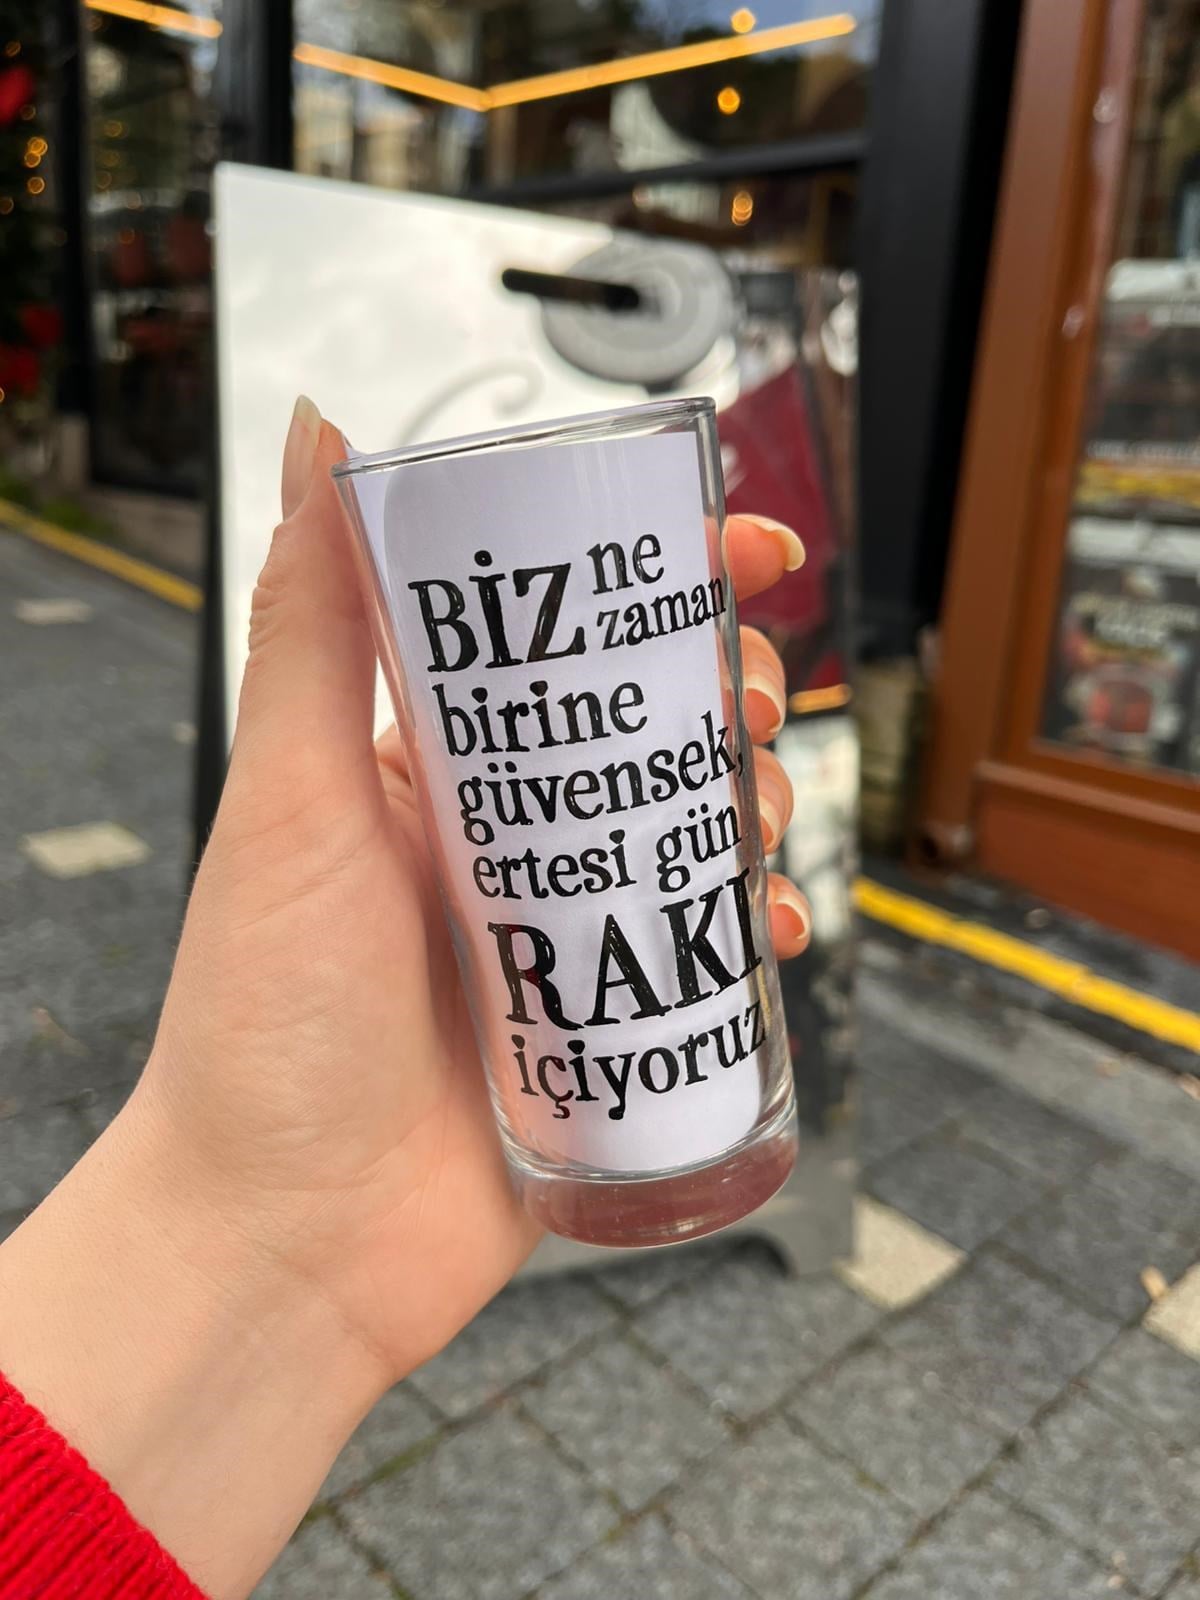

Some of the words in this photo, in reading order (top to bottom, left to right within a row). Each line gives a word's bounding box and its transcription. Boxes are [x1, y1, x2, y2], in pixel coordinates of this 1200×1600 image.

[408, 550, 587, 673] BİZ
[586, 533, 664, 595] ne
[597, 576, 727, 650] zaman
[432, 680, 648, 757] birine
[457, 710, 745, 846] güvensek,
[473, 829, 637, 900] ertesi
[656, 803, 742, 893] gün
[487, 867, 762, 1031] RAKI
[511, 1000, 766, 1121] içiyoruz
